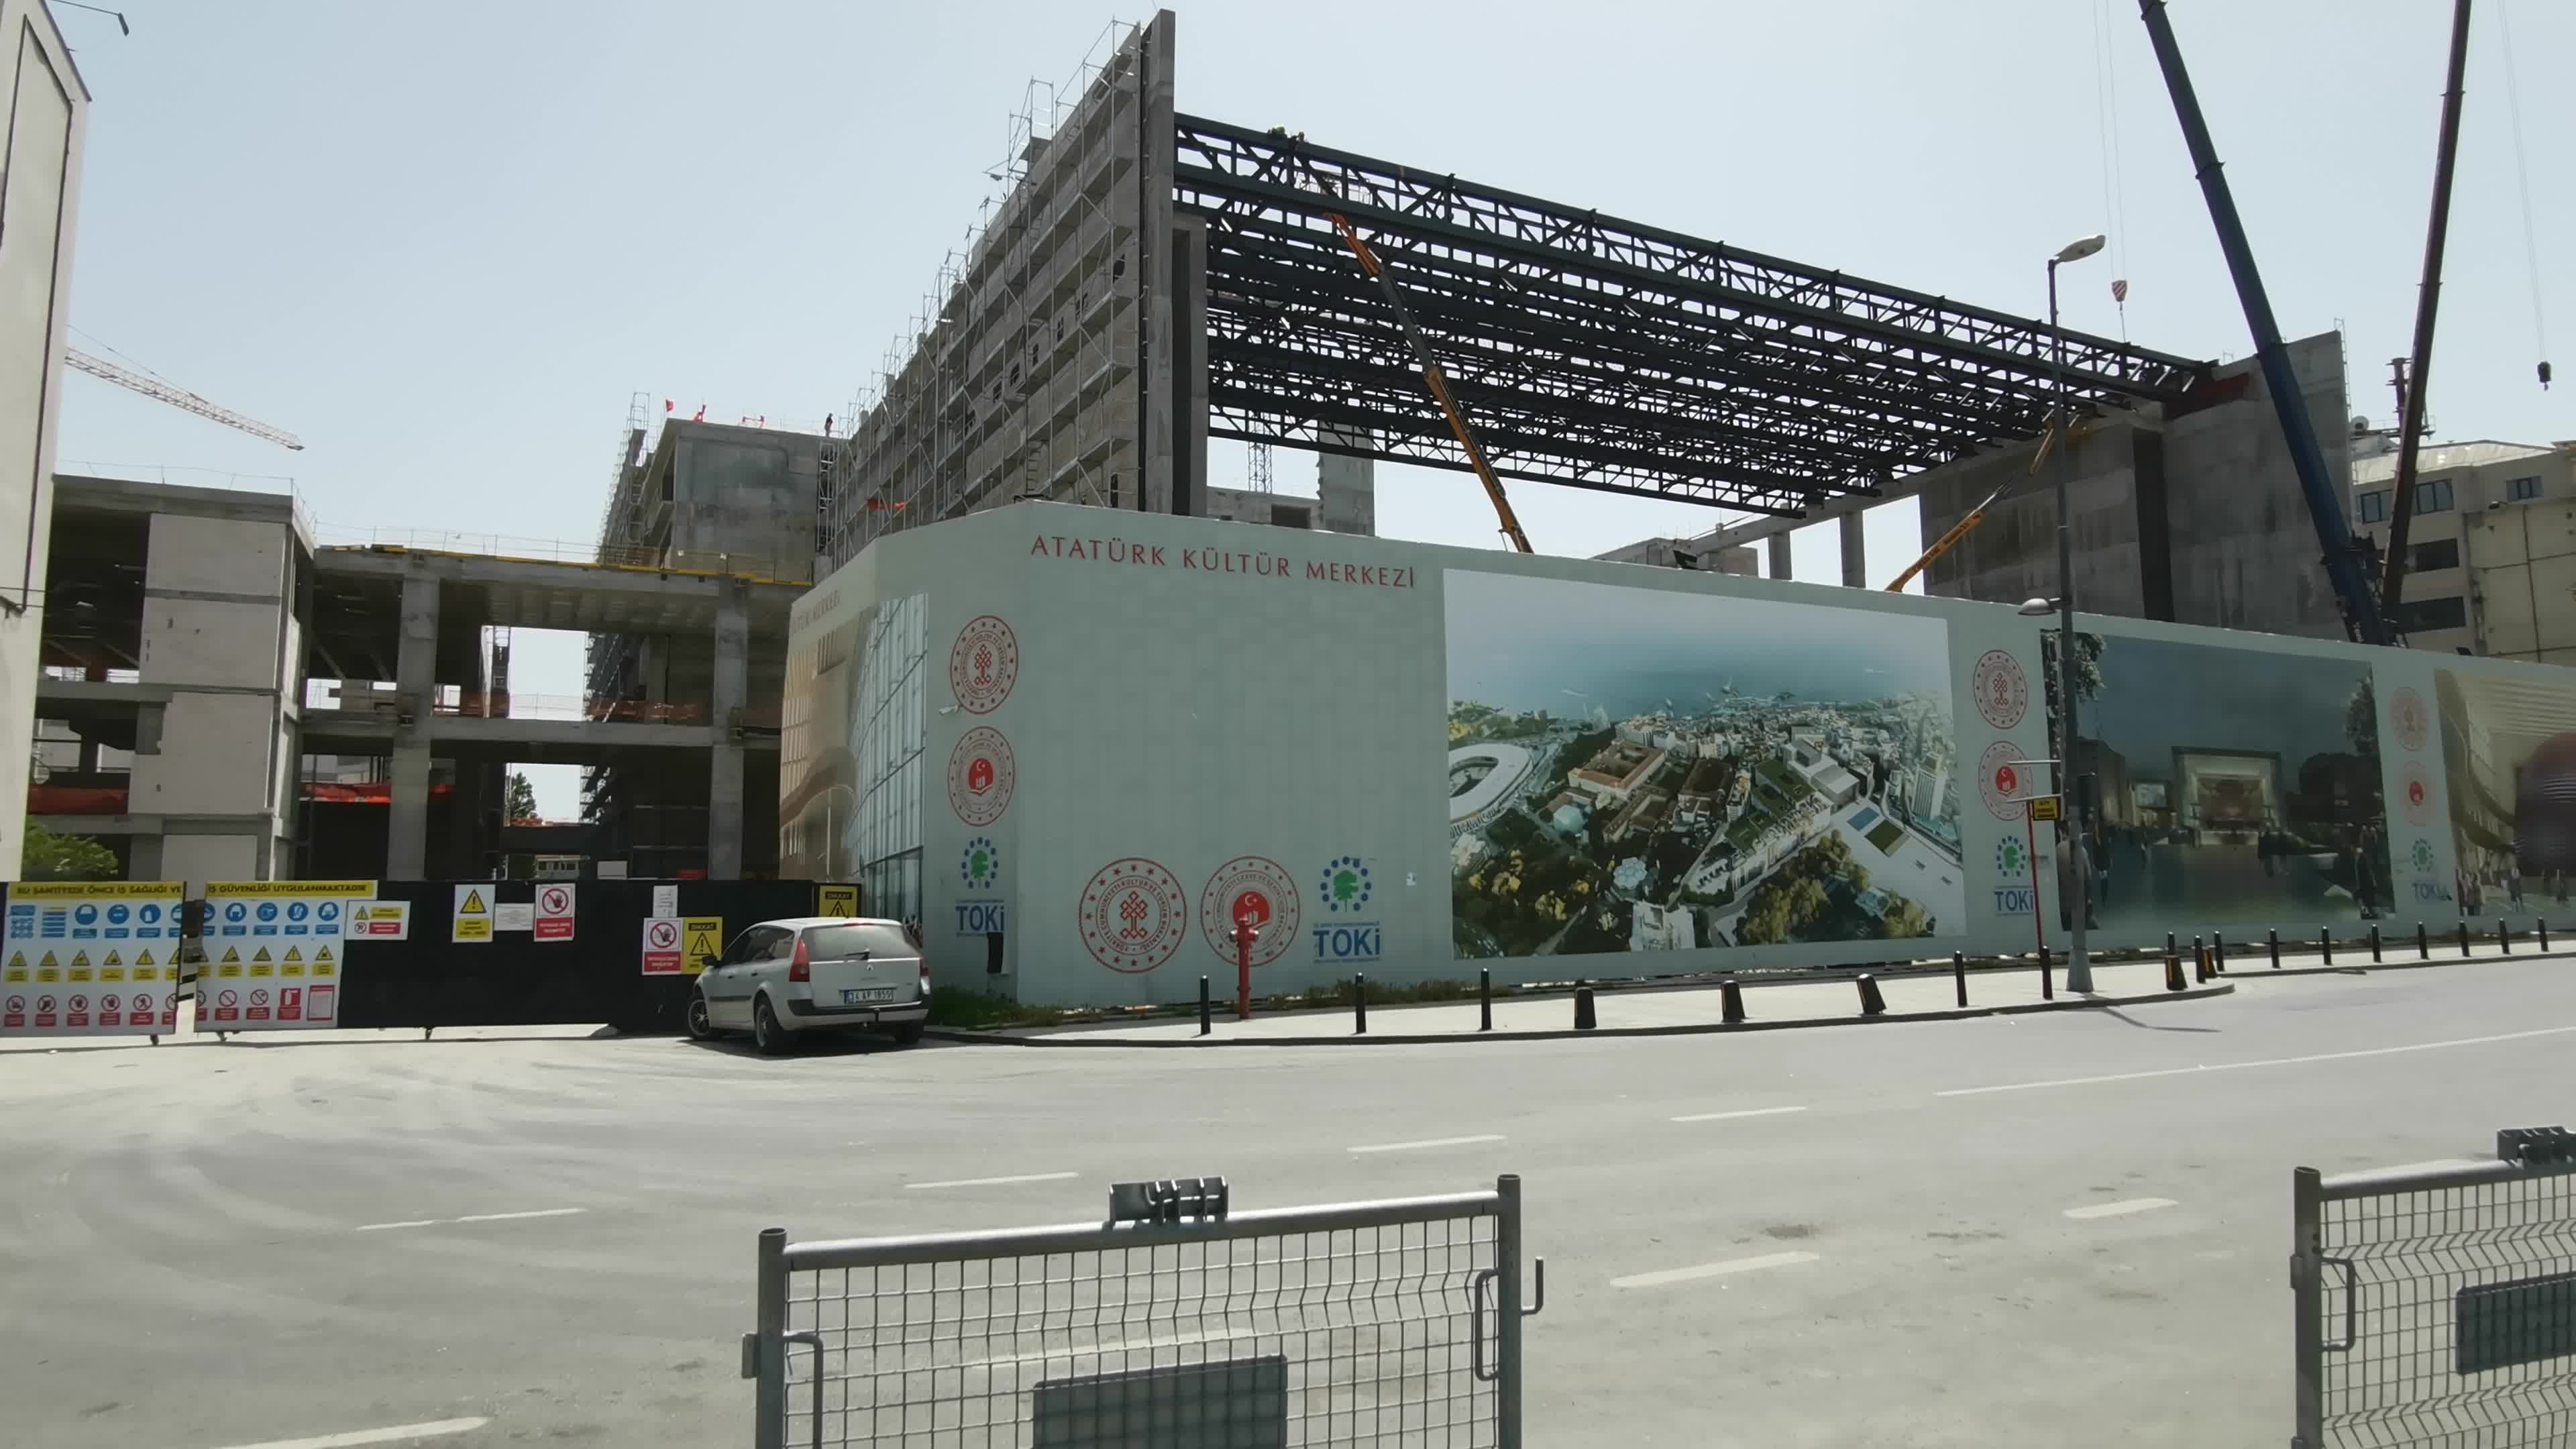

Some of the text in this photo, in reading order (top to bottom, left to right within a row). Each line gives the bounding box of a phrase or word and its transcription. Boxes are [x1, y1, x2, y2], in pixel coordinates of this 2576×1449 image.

[1030, 535, 1416, 588] ATATÜRK KÜLTÜR MERKEZİ
